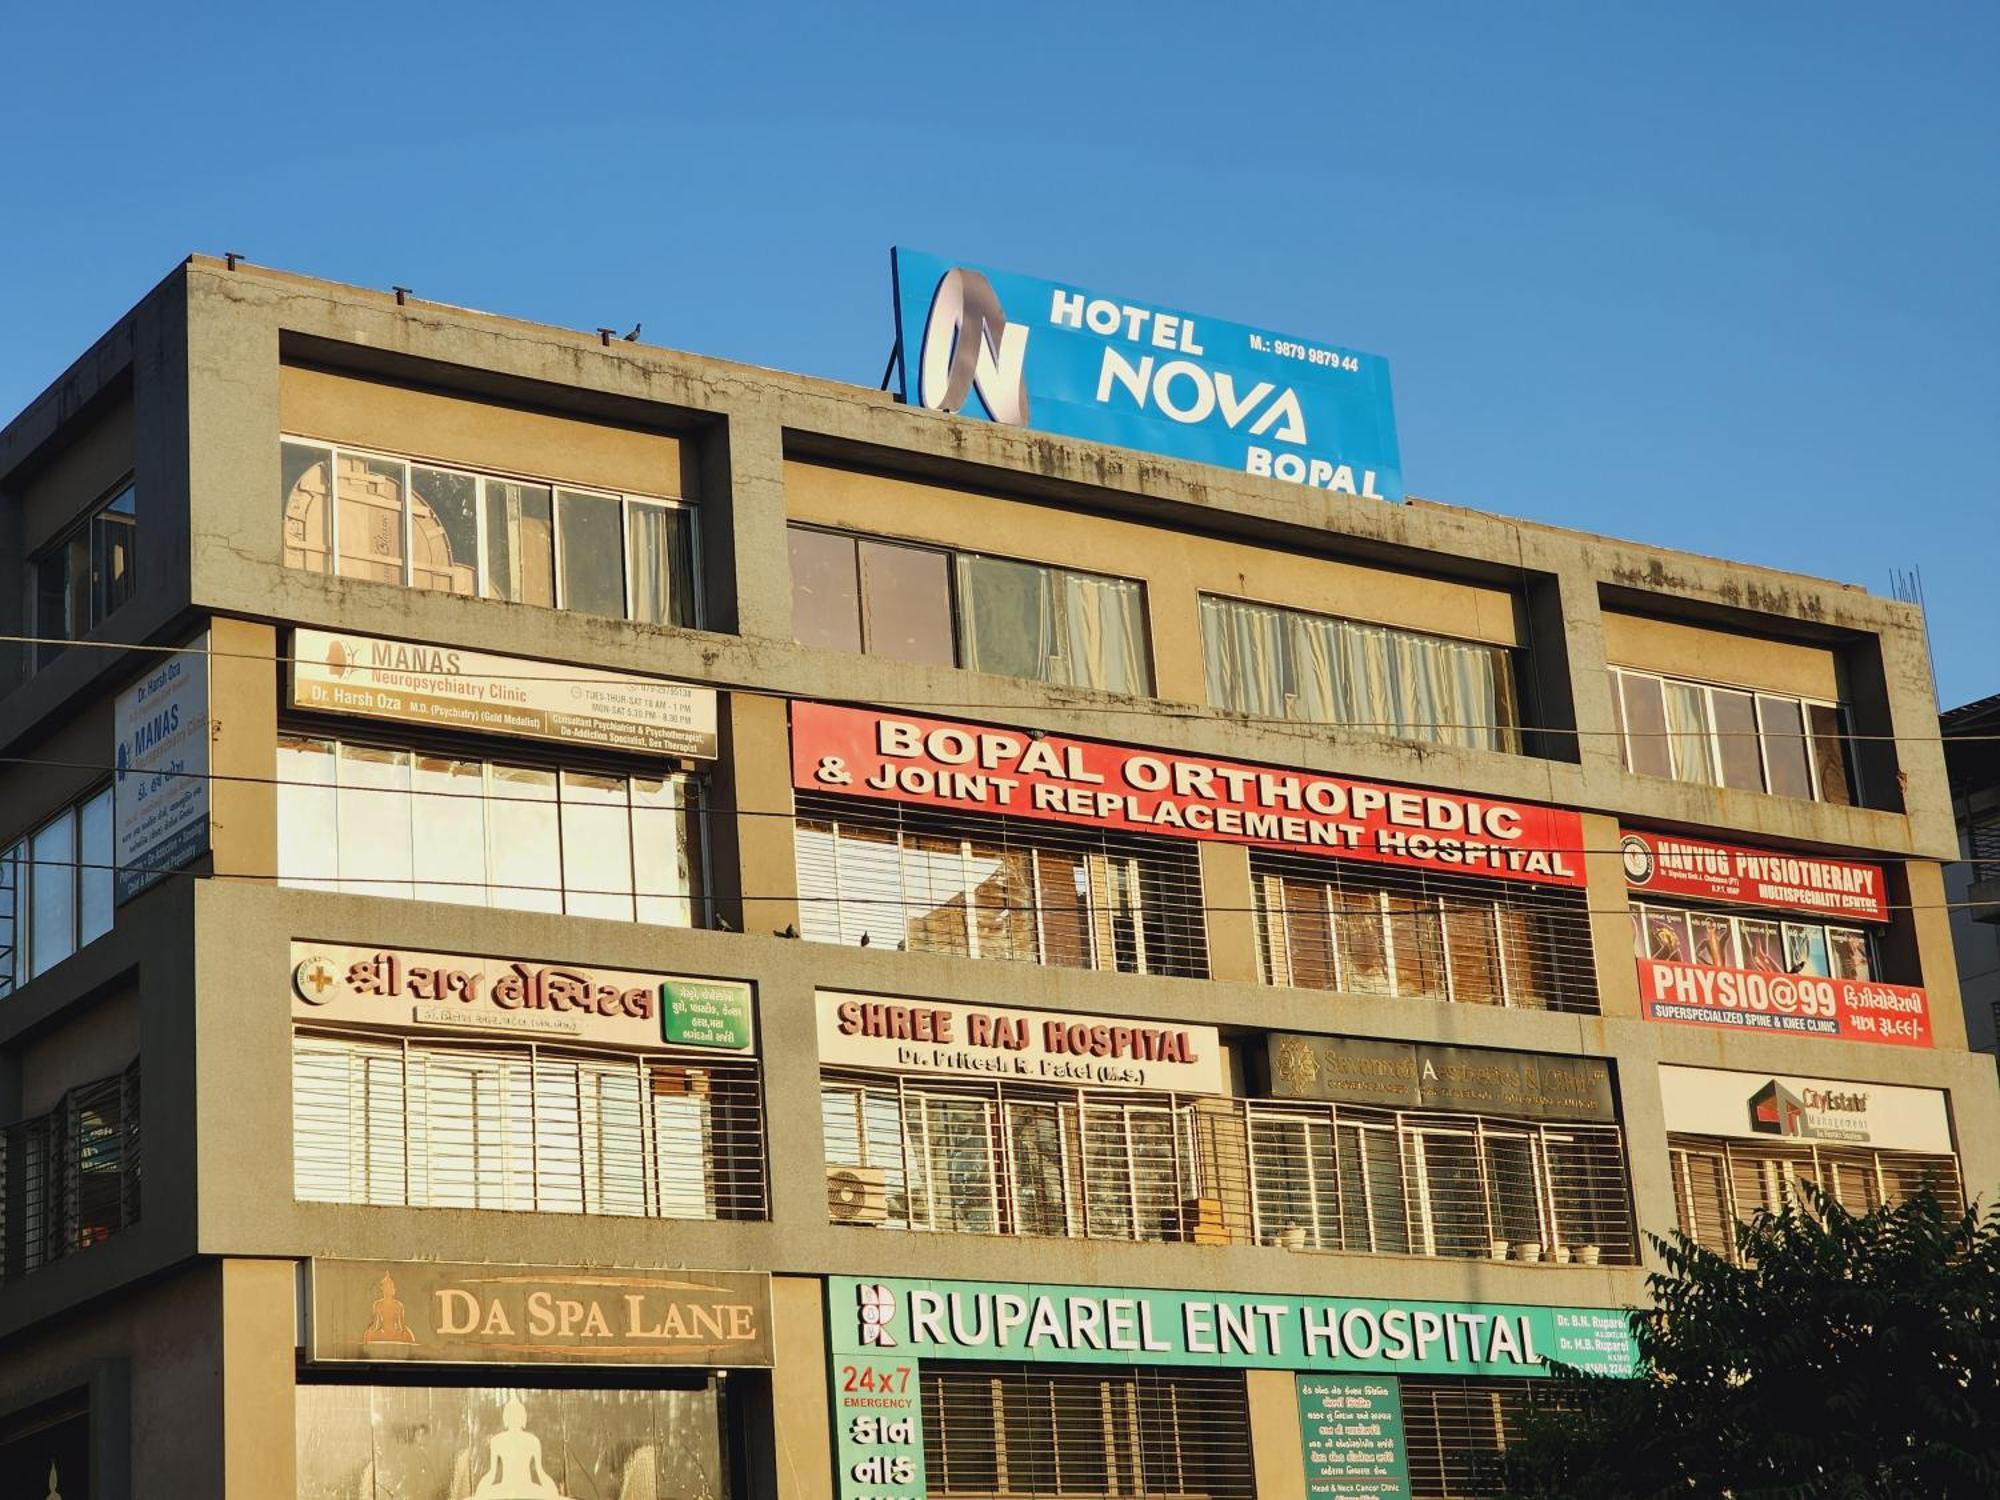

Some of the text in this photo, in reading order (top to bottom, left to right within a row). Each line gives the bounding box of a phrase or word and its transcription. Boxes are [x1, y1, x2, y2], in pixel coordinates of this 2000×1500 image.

[1050, 289, 1204, 355] HOTEL
[1274, 340, 1305, 361] 9879
[1308, 348, 1339, 369] 9879
[1342, 356, 1359, 372] 44
[1096, 346, 1308, 445] NOVA
[1246, 446, 1384, 500] BOPAL
[371, 641, 461, 675] MANAS
[311, 687, 402, 712] Dr. Harsh Oza
[371, 668, 528, 703] Neuropsychiatry Clinic
[135, 703, 179, 757] MANAS
[410, 702, 540, 730] M.D. (Psychiatry) (Gold Medalist)
[877, 719, 1523, 841] BOPAL ORTHOPEDIC
[815, 756, 852, 786] &
[867, 763, 1018, 805] JOINT
[1032, 782, 1366, 850] REPLACEMENT
[1376, 828, 1575, 878] HOSPITAL
[1657, 841, 1730, 876] NAVYUG
[1735, 852, 1874, 894] PHYSIOTHERAPY
[1758, 883, 1841, 908] MULTISPECIALITY
[346, 953, 401, 996] શ્રી
[407, 967, 483, 1002] રાજ
[492, 963, 654, 1018] હોસ્પિટલ
[1653, 965, 1837, 1017] PHYSIO@99
[837, 1002, 1198, 1063] SHREE RAJ HOSPITAL
[1655, 1006, 1837, 1033] SUPERSPECIALIZED SPINE & KNEE CLINIC
[898, 1047, 928, 1066] Dr.
[933, 1050, 1007, 1073] Pritesh
[1040, 1060, 1092, 1079] Patel
[907, 1290, 1543, 1365] RUPAREL ENT HOSPITAL
[843, 1398, 912, 1409] EMERGENCY
